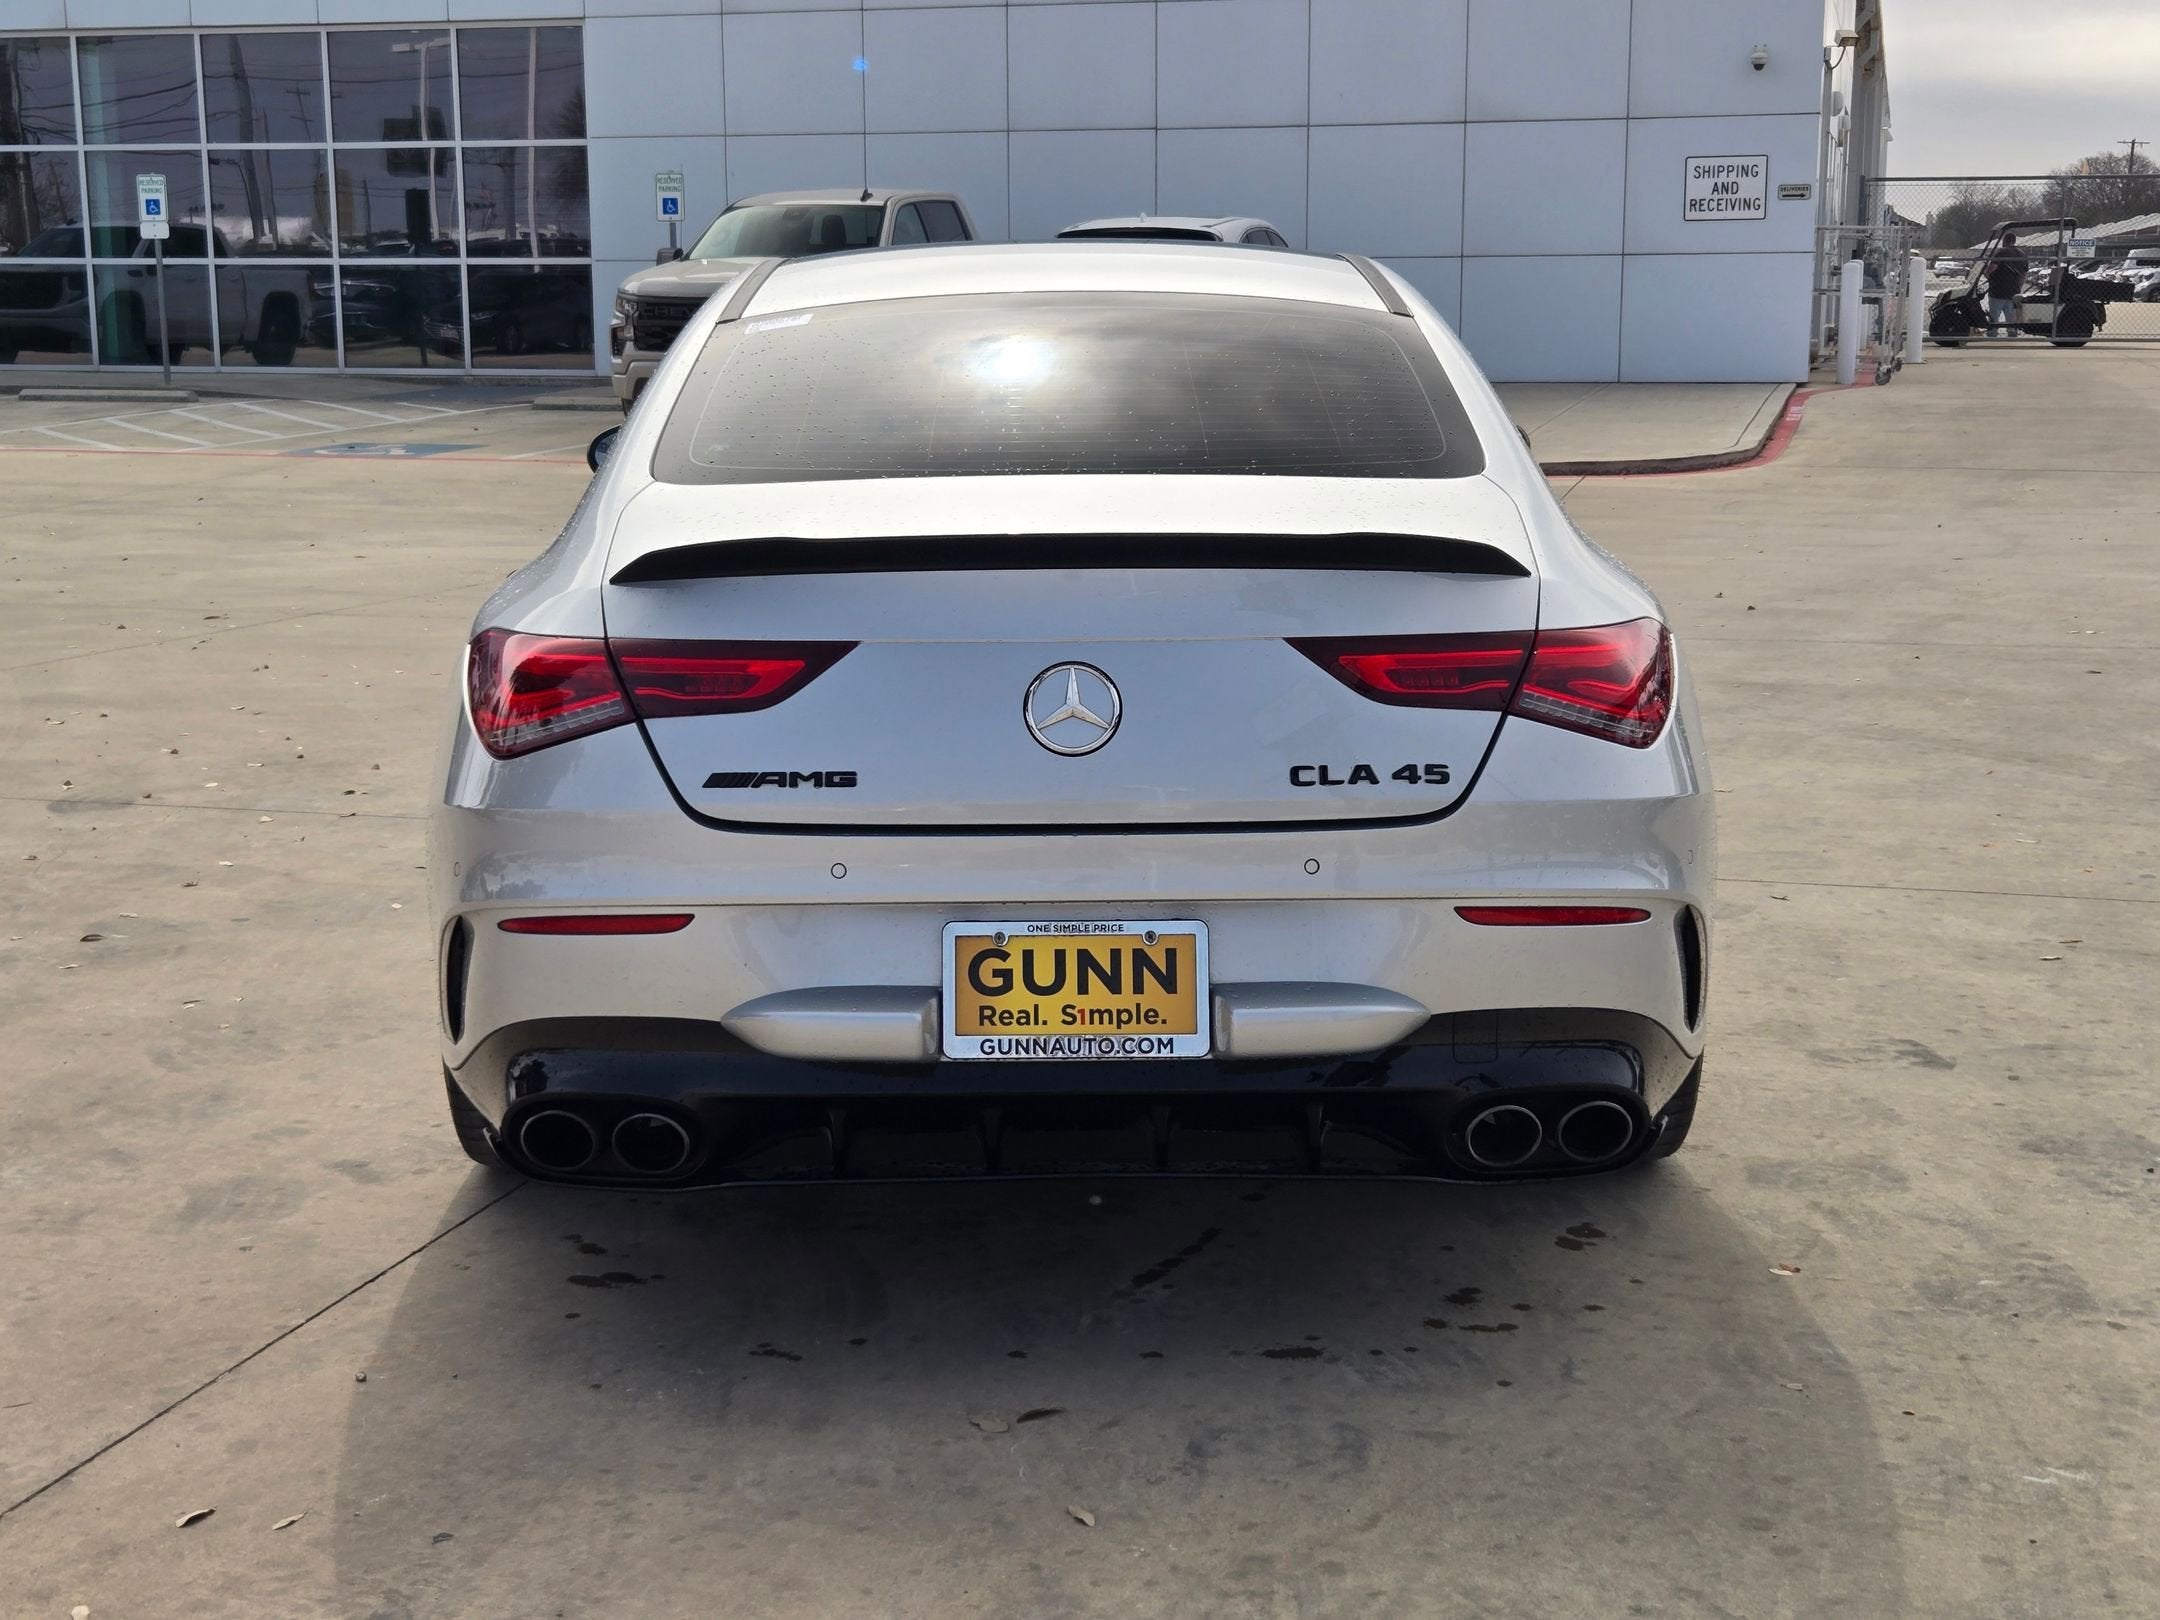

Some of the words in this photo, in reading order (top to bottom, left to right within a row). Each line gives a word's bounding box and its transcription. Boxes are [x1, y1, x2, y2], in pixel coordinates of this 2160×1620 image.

[1693, 164, 1759, 179] SHIPPING
[1711, 181, 1739, 195] AND
[1689, 197, 1761, 212] RECEIVING
[750, 771, 857, 789] AMG
[1289, 764, 1380, 787] CLA
[1391, 764, 1450, 785] 45
[1027, 924, 1049, 933] ONE
[1053, 924, 1090, 933] SIMPLE
[1094, 923, 1124, 932] PRICE
[968, 947, 1178, 997] GUNN
[978, 1004, 1048, 1027] Real.
[980, 1037, 1174, 1056] GUNNAUTO.COM
